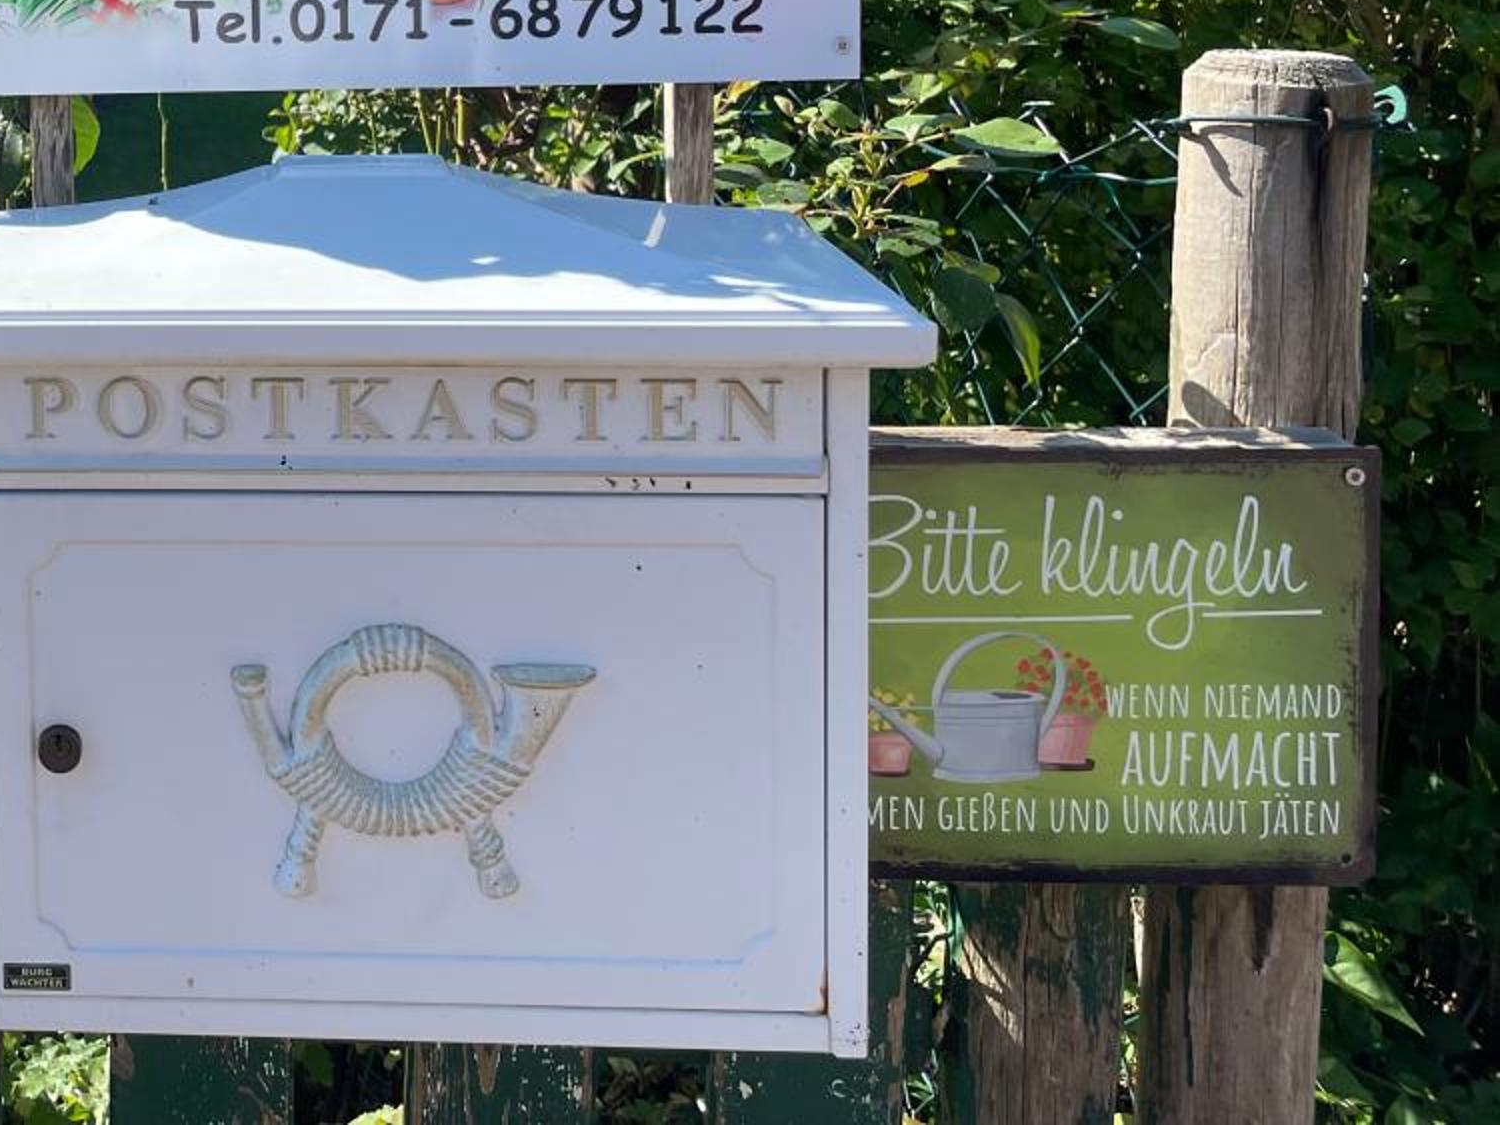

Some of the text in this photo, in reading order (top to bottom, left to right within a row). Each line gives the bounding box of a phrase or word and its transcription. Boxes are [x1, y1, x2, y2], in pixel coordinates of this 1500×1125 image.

[22, 375, 785, 445] POSTKASTEN
[868, 493, 1308, 651] Bitte klingeln
[1105, 682, 1341, 721] WENN NIEMAND
[1121, 730, 1341, 791] AUFMACHT
[937, 792, 1037, 833] GIEßEN
[1050, 796, 1110, 833] UND
[1123, 793, 1249, 836] UNKRAUT
[1259, 792, 1341, 840] JÄTEN
